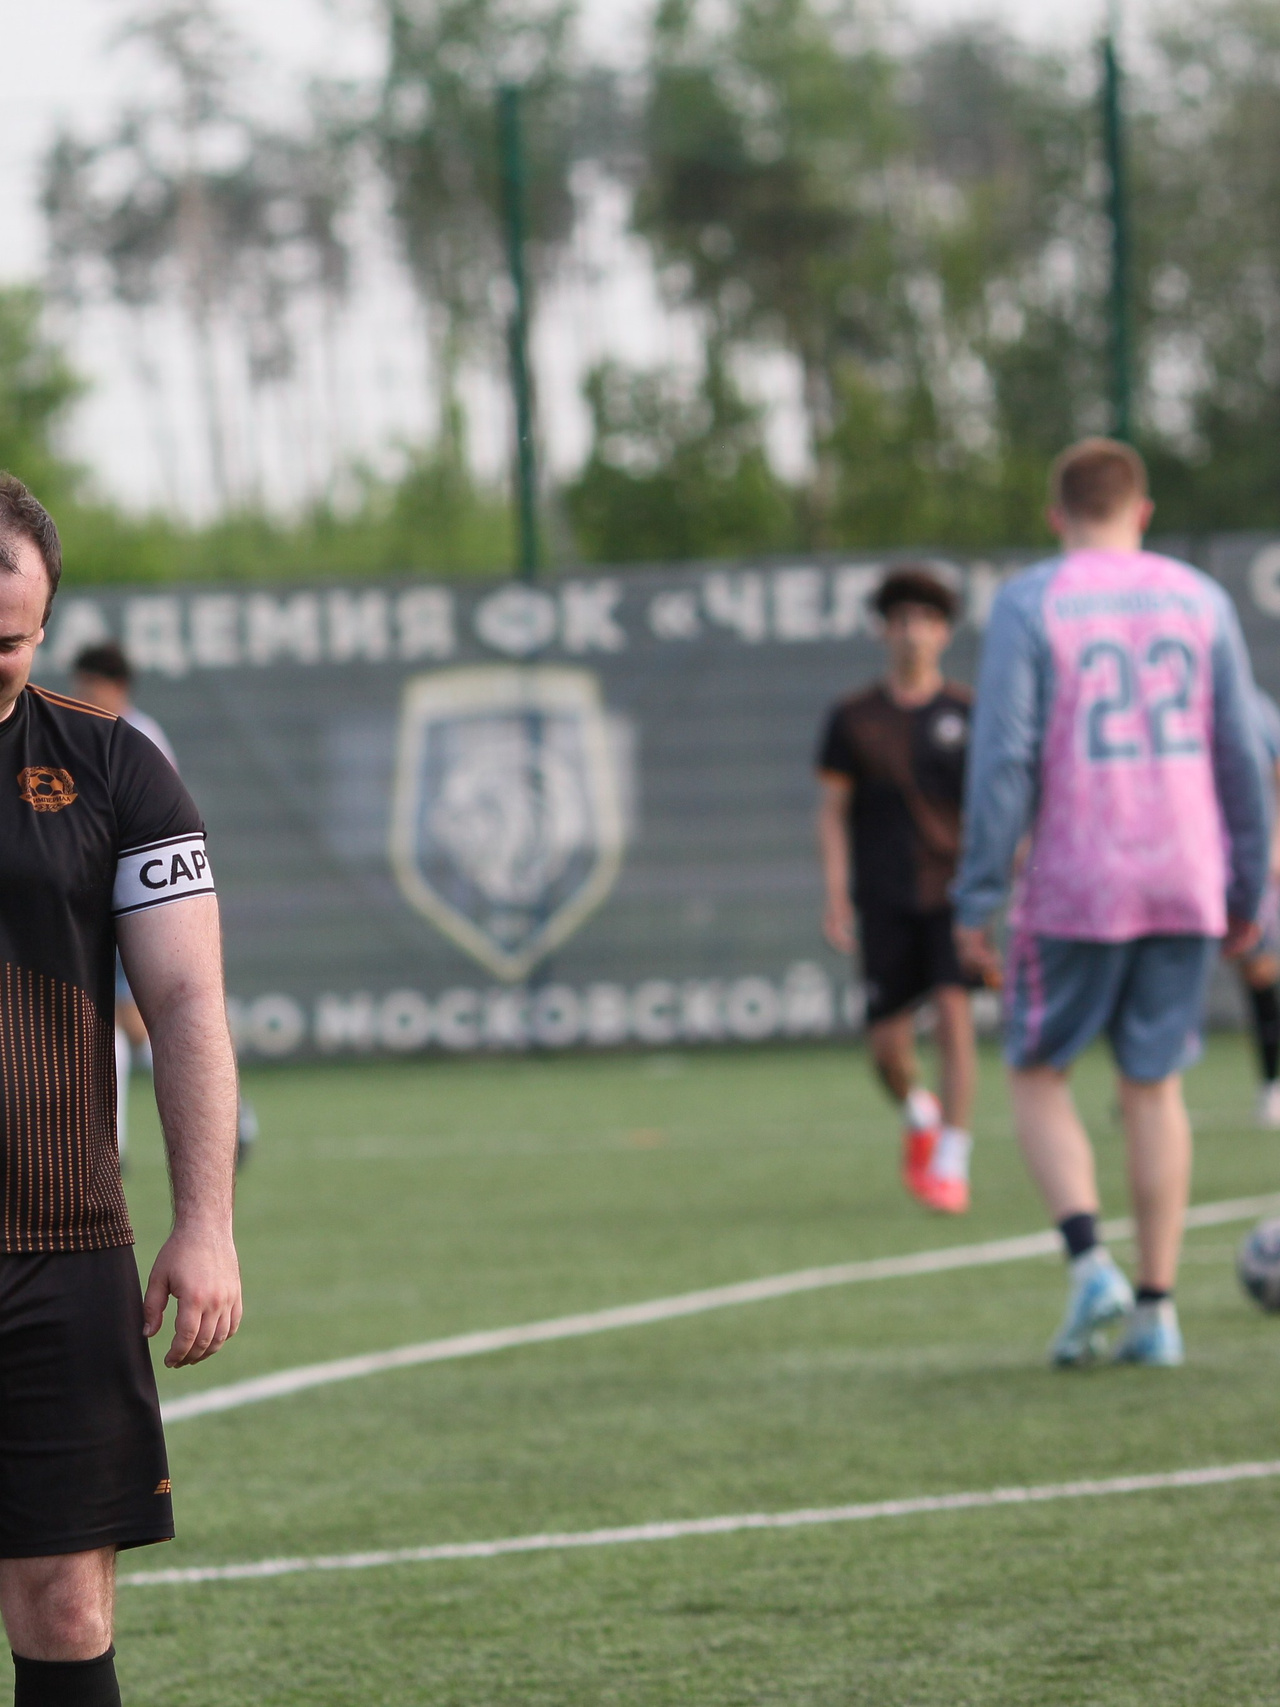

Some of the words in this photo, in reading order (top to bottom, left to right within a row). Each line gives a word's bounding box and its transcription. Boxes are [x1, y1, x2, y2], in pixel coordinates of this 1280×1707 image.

[30, 586, 455, 678] АДЕМИЯ
[474, 580, 624, 660] ФК
[649, 564, 998, 643] «ЧЕЛ
[1080, 638, 1192, 762] 22
[139, 850, 207, 889] CAP
[316, 963, 834, 1050] МОСКОВСКОЙ
